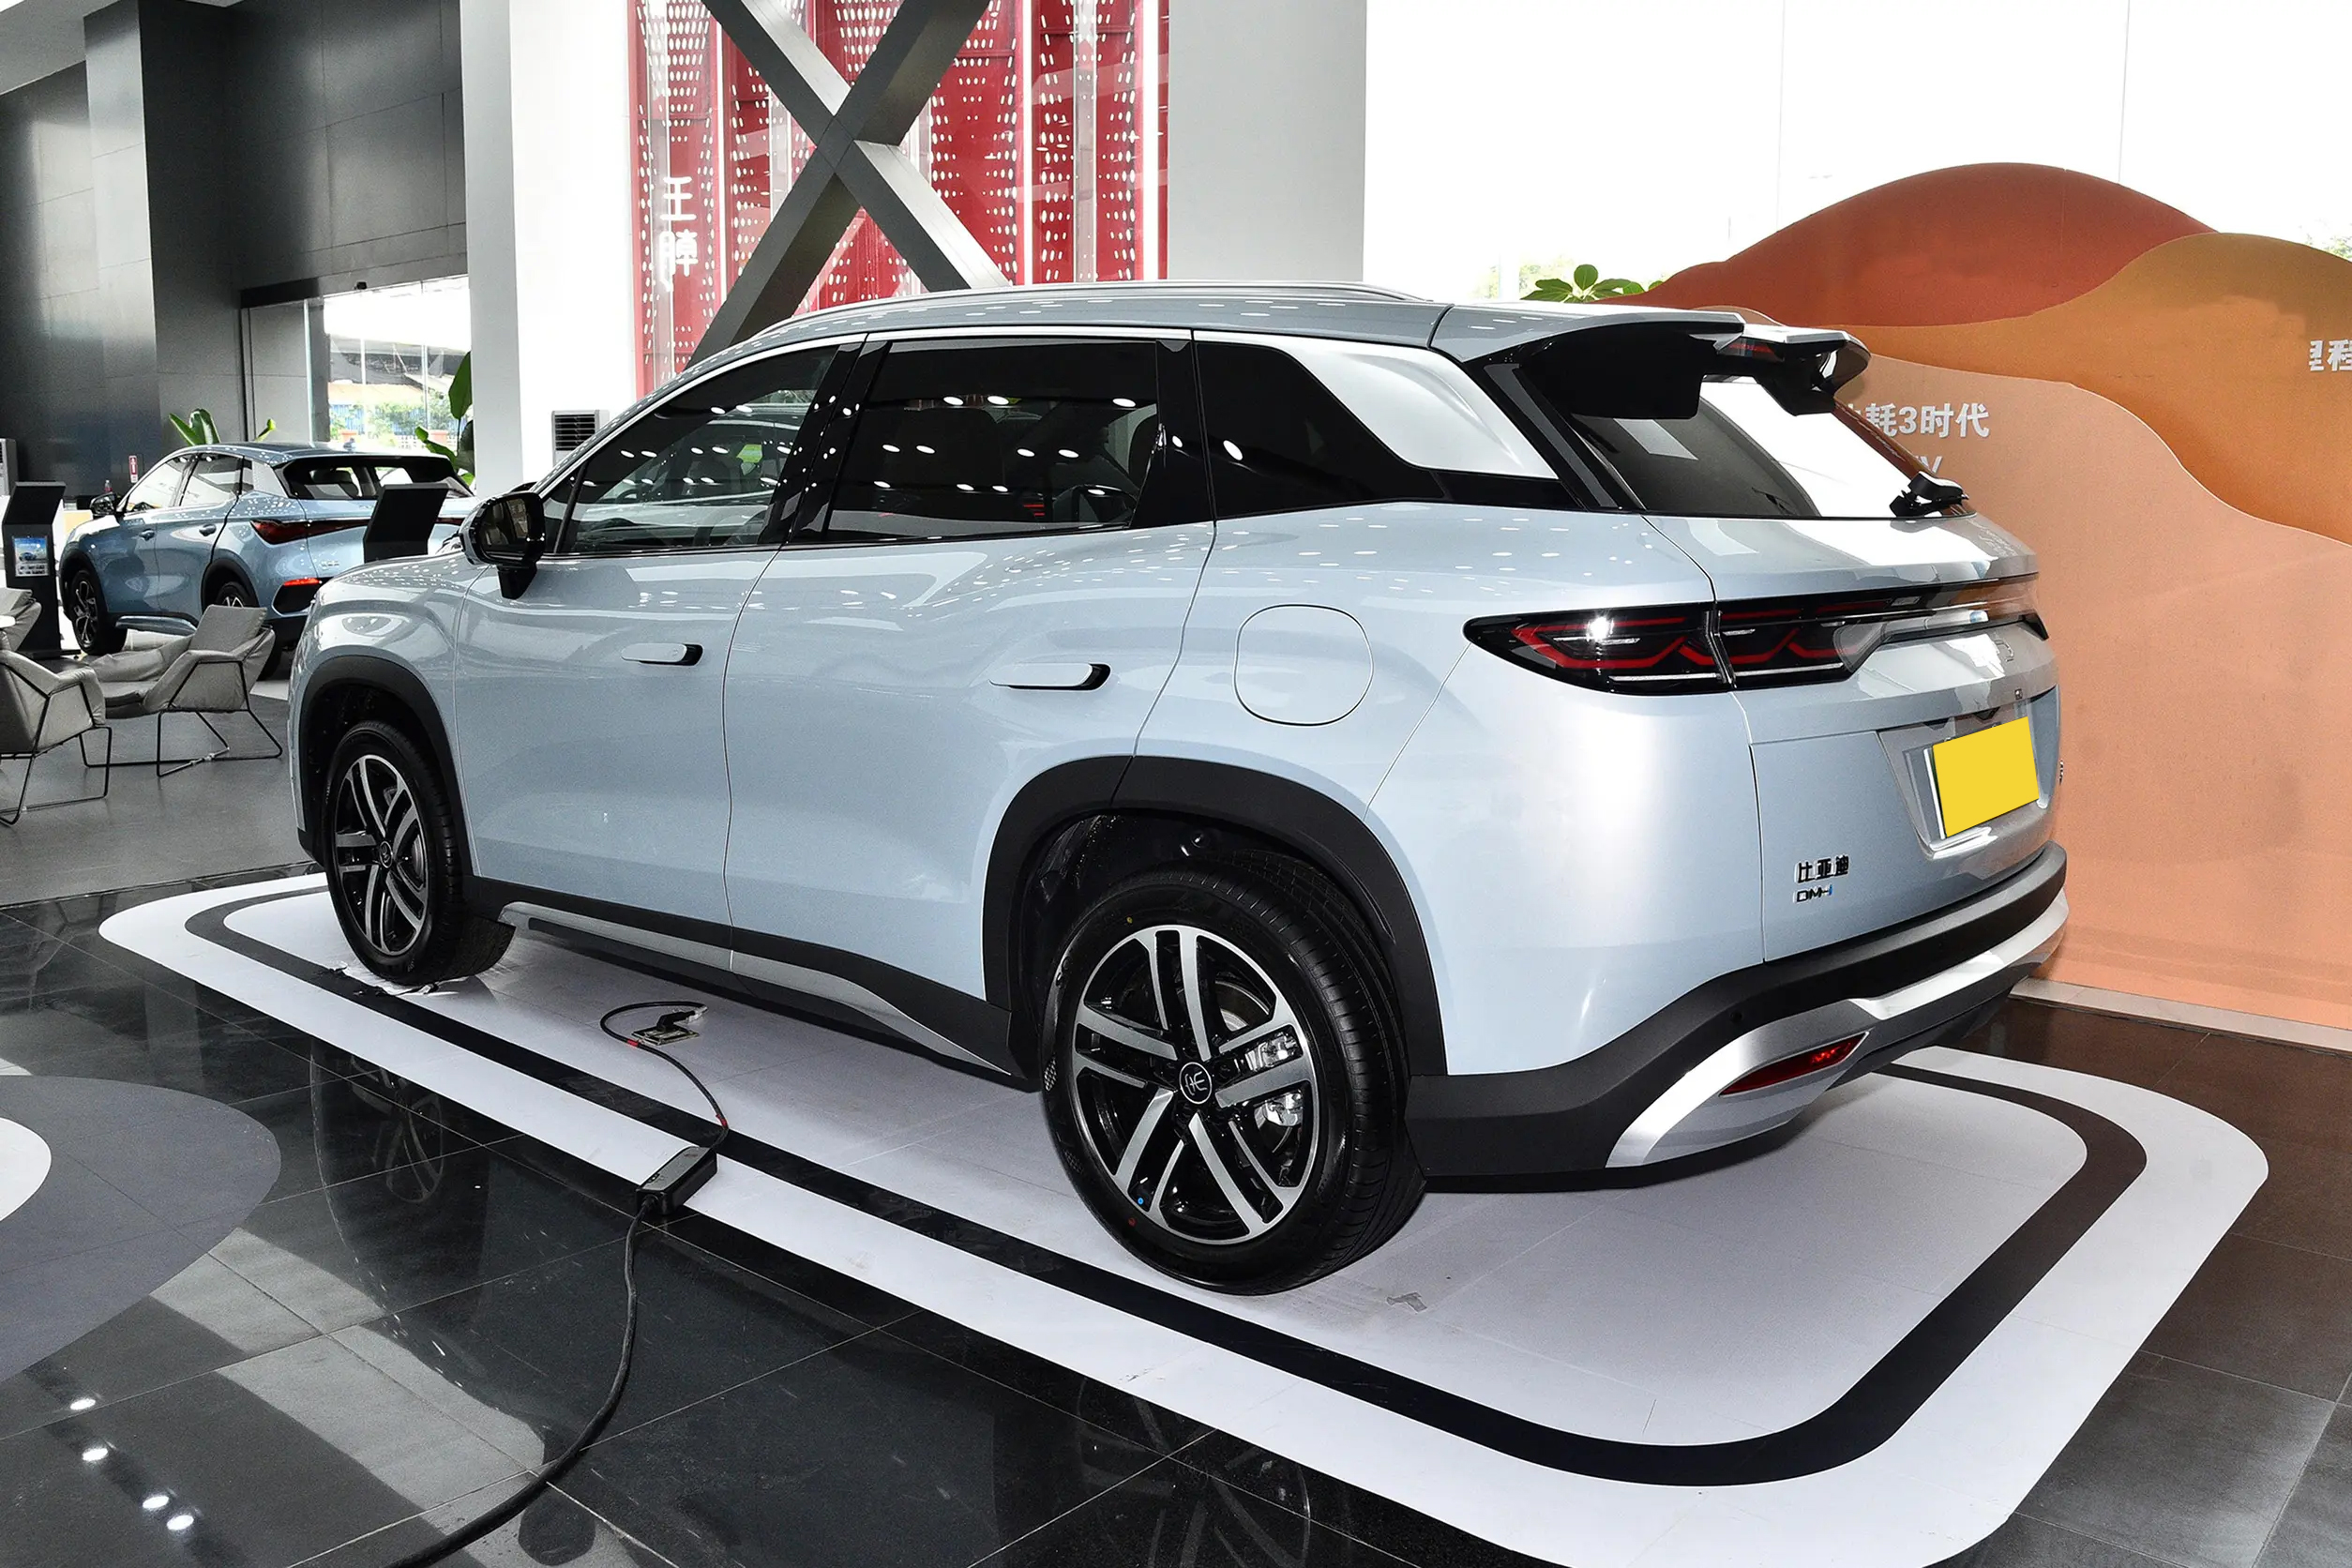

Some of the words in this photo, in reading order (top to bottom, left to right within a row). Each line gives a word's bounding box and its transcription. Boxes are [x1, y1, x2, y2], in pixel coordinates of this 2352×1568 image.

[1848, 403, 1990, 438] 耗3时代
[1795, 854, 1849, 883] 比亚迪
